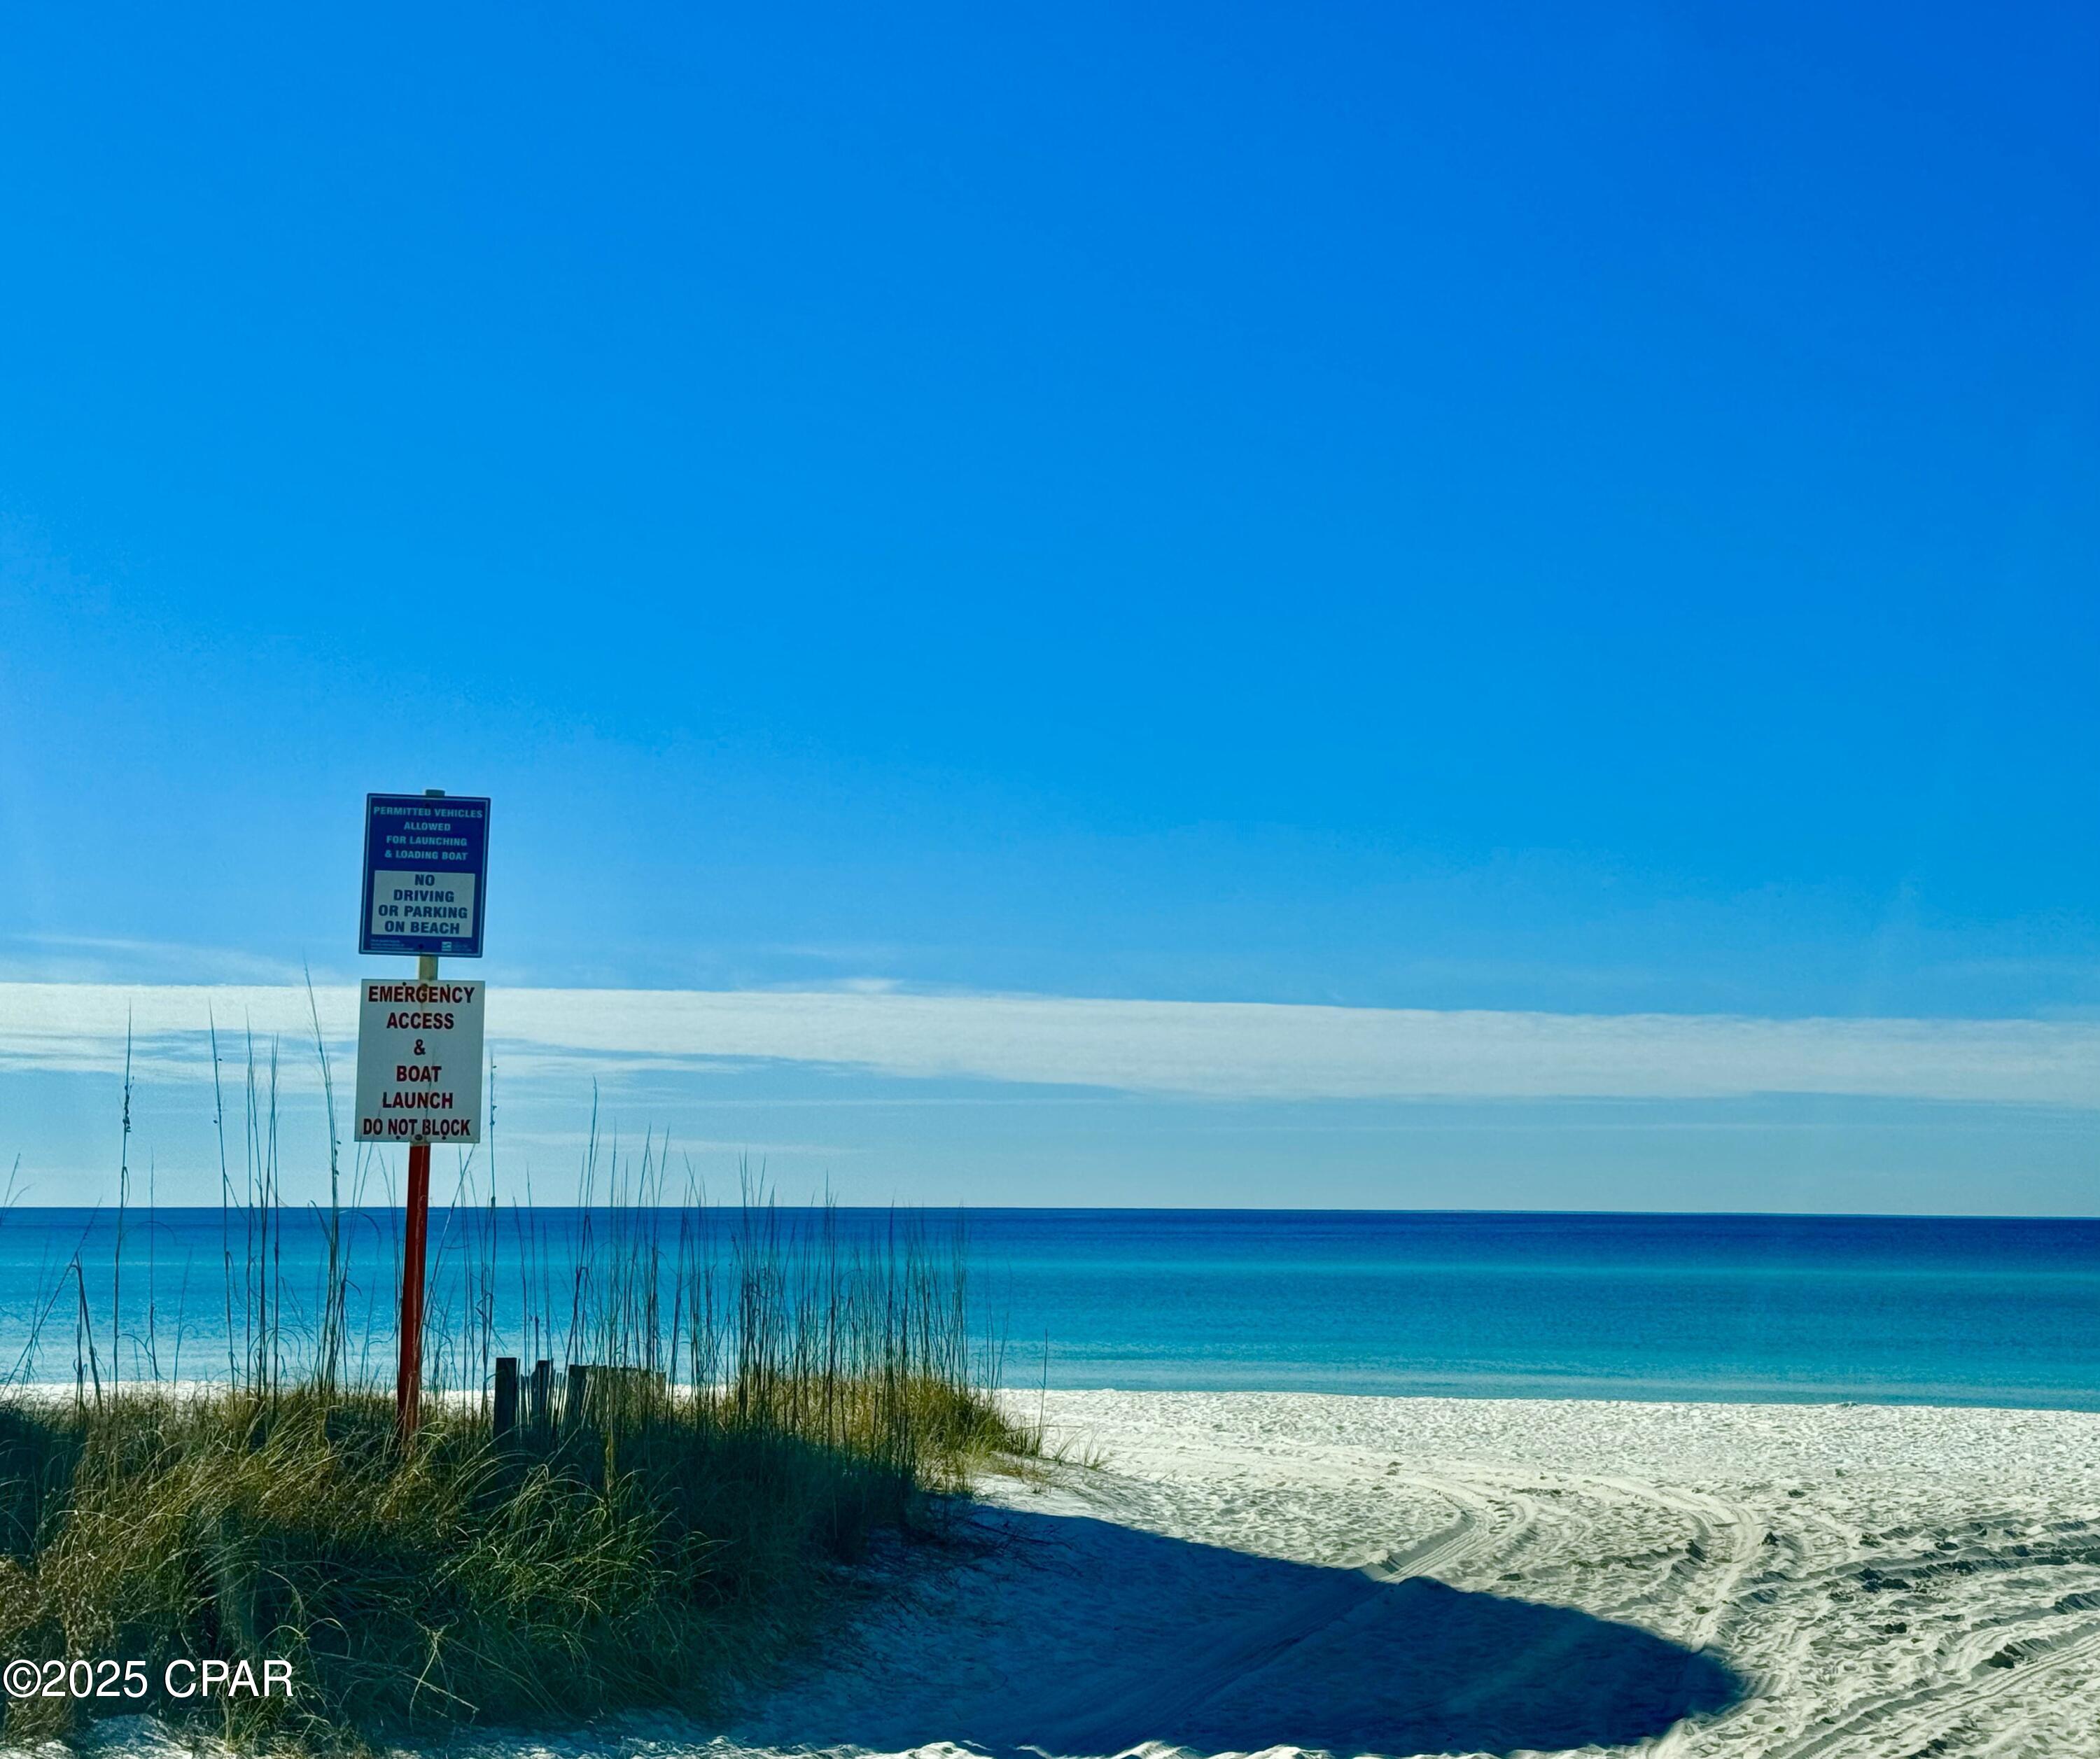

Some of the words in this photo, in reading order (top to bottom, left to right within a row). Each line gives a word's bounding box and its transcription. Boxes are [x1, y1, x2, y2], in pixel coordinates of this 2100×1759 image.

[374, 806, 430, 816] PERMITTED
[435, 808, 483, 818] VEHICLES
[404, 822, 451, 831] ALLOWED
[410, 836, 467, 846] LAUNCHING
[396, 850, 438, 860] LOADING
[442, 852, 468, 860] BOAT
[414, 874, 435, 886] NO
[393, 889, 454, 902] DRIVING
[378, 904, 398, 916] OR
[404, 906, 467, 918] PARKING
[385, 920, 405, 932] ON
[410, 922, 460, 934] BEACH
[368, 986, 475, 1003] EMERGENCY
[386, 1012, 454, 1030] ACCESS
[414, 1039, 426, 1056] &
[396, 1065, 442, 1082] BOAT
[382, 1092, 453, 1109] LAUNCH
[363, 1119, 383, 1135] DO
[388, 1119, 417, 1135] NOT
[422, 1119, 471, 1136] BLOCK
